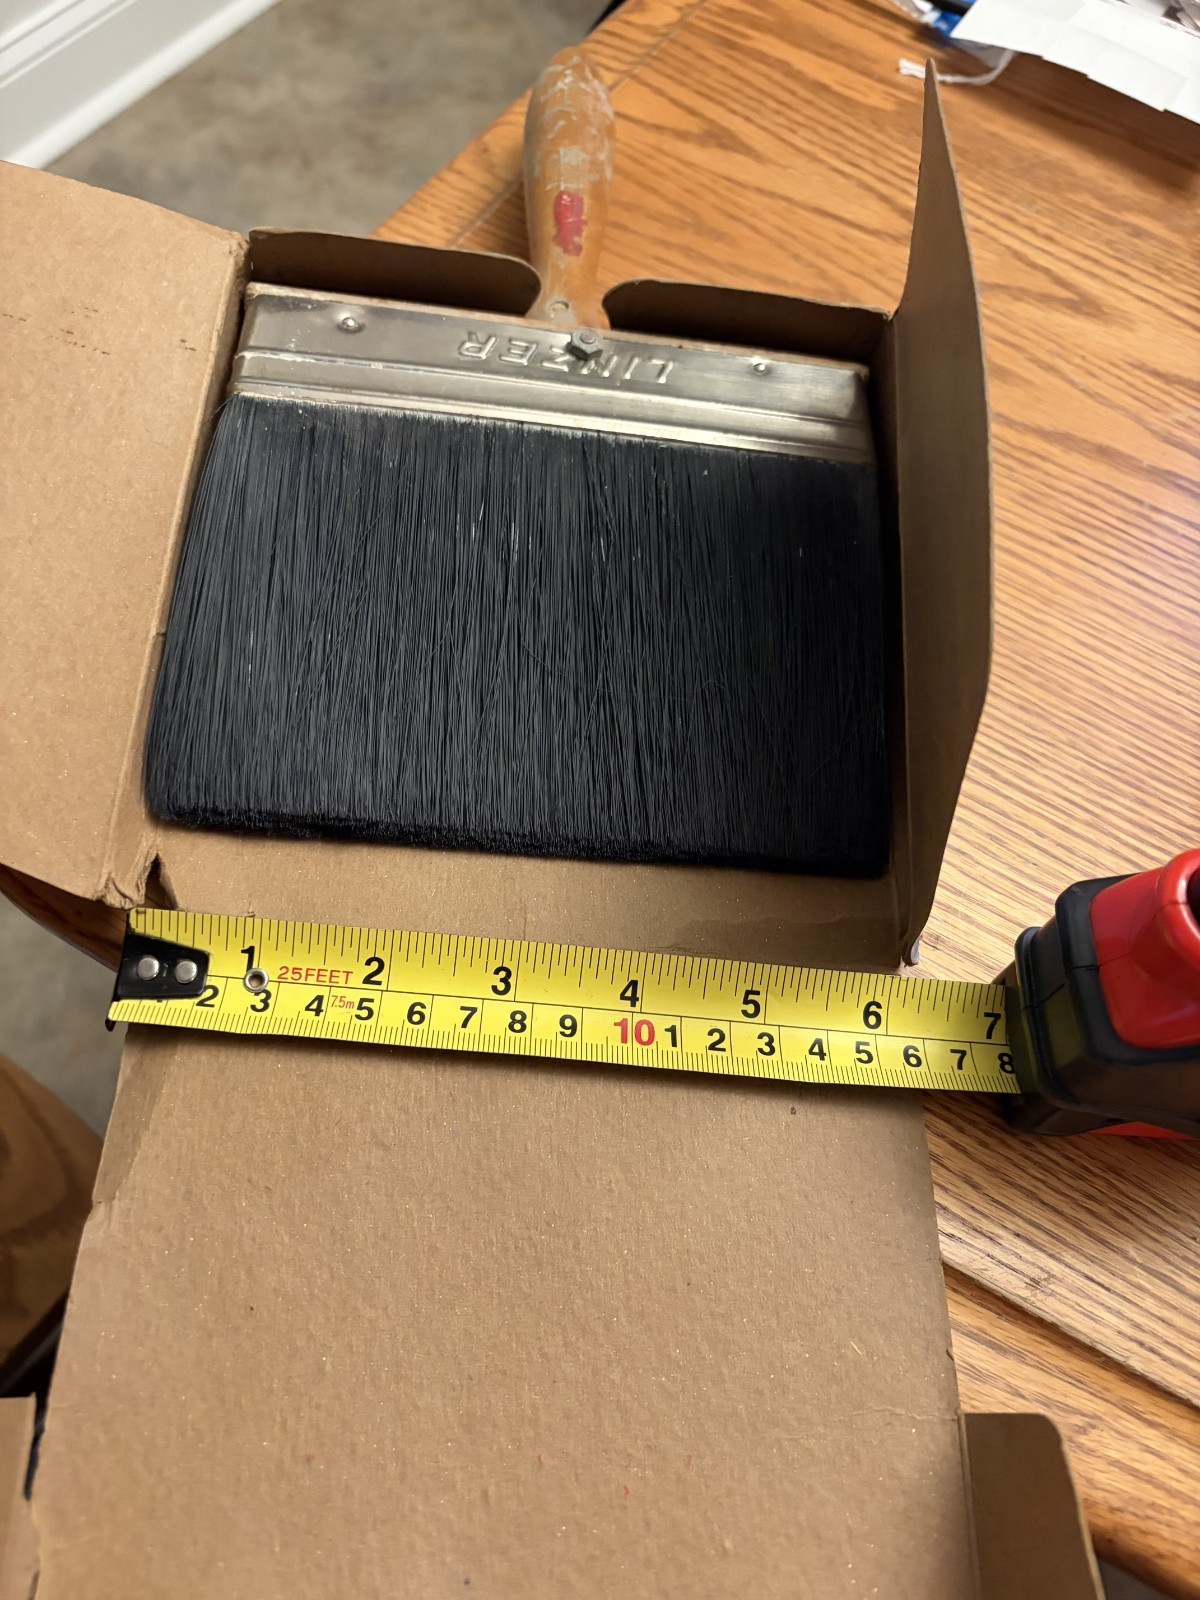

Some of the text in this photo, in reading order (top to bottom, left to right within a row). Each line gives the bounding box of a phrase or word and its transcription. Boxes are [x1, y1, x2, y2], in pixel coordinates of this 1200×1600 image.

[241, 946, 1002, 1040] 1 2 3 4 5 6 7
[278, 966, 354, 985] 25FEET
[195, 985, 1015, 1074] 2 3 4 5 6 7 8 9 10 1 2 3 4 5 6 7 8
